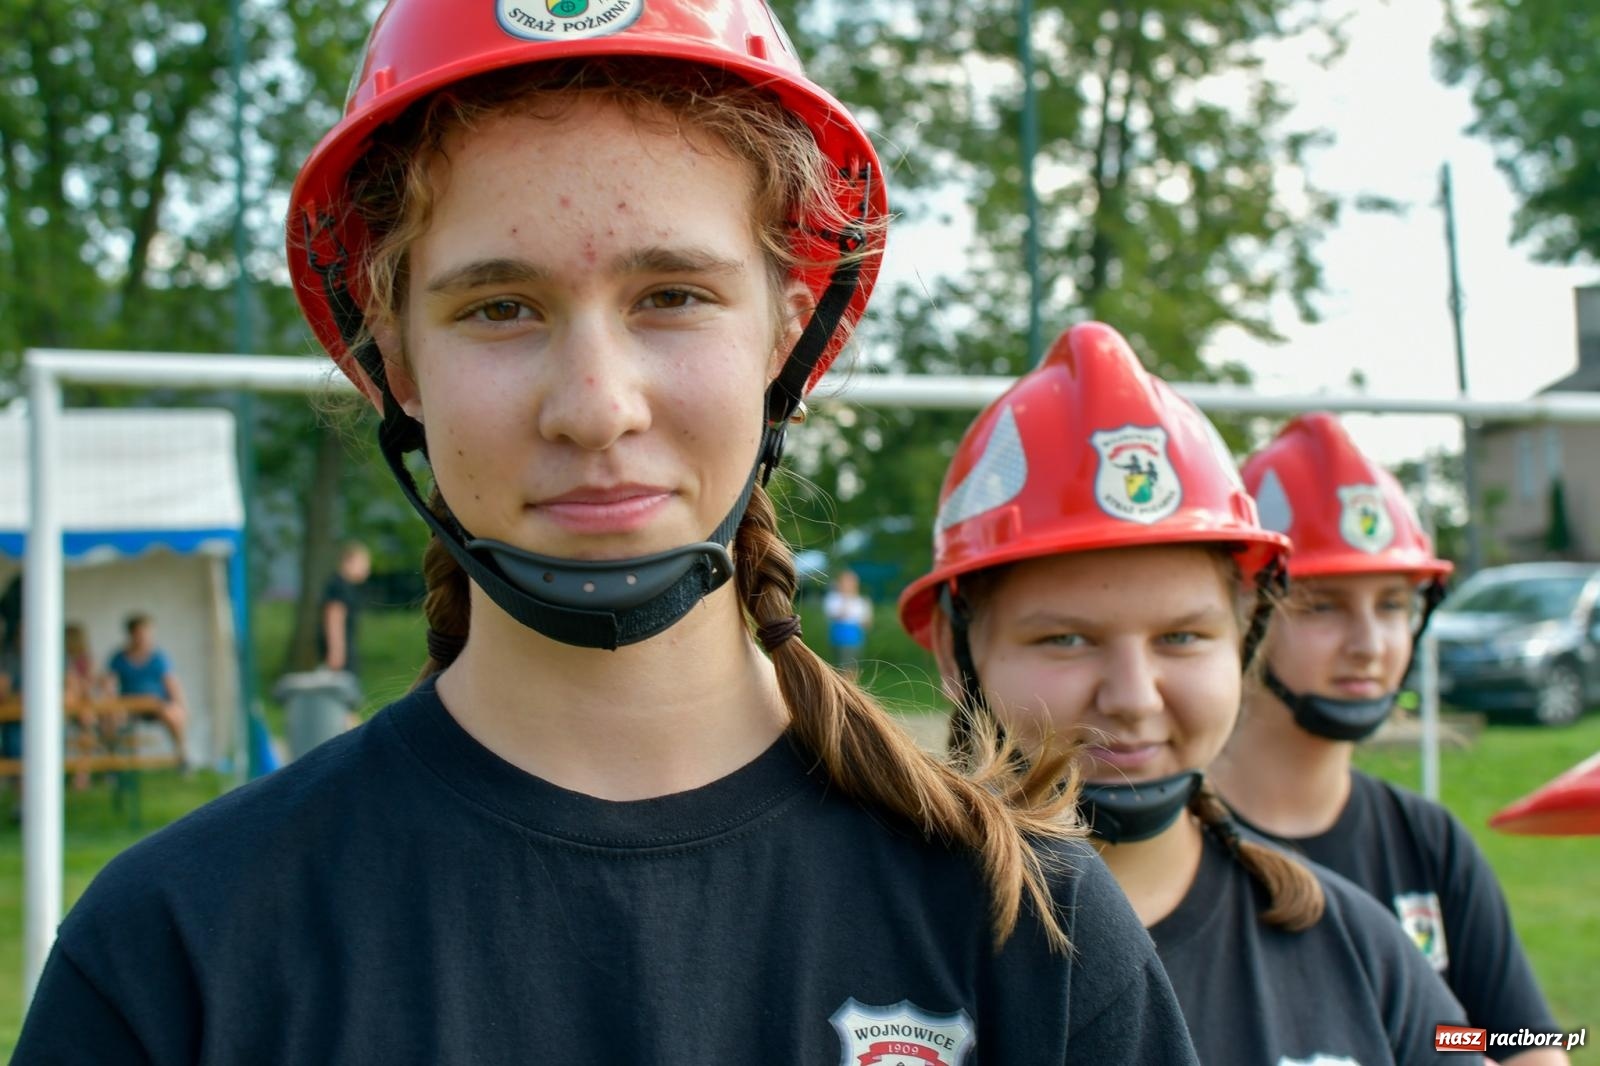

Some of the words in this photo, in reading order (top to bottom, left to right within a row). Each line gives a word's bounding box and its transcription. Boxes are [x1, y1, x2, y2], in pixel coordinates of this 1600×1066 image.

[508, 8, 555, 32] STRAŻ
[563, 0, 631, 32] POŻARNA
[854, 1024, 956, 1051] WOJNOWICE
[888, 1044, 919, 1055] 1909
